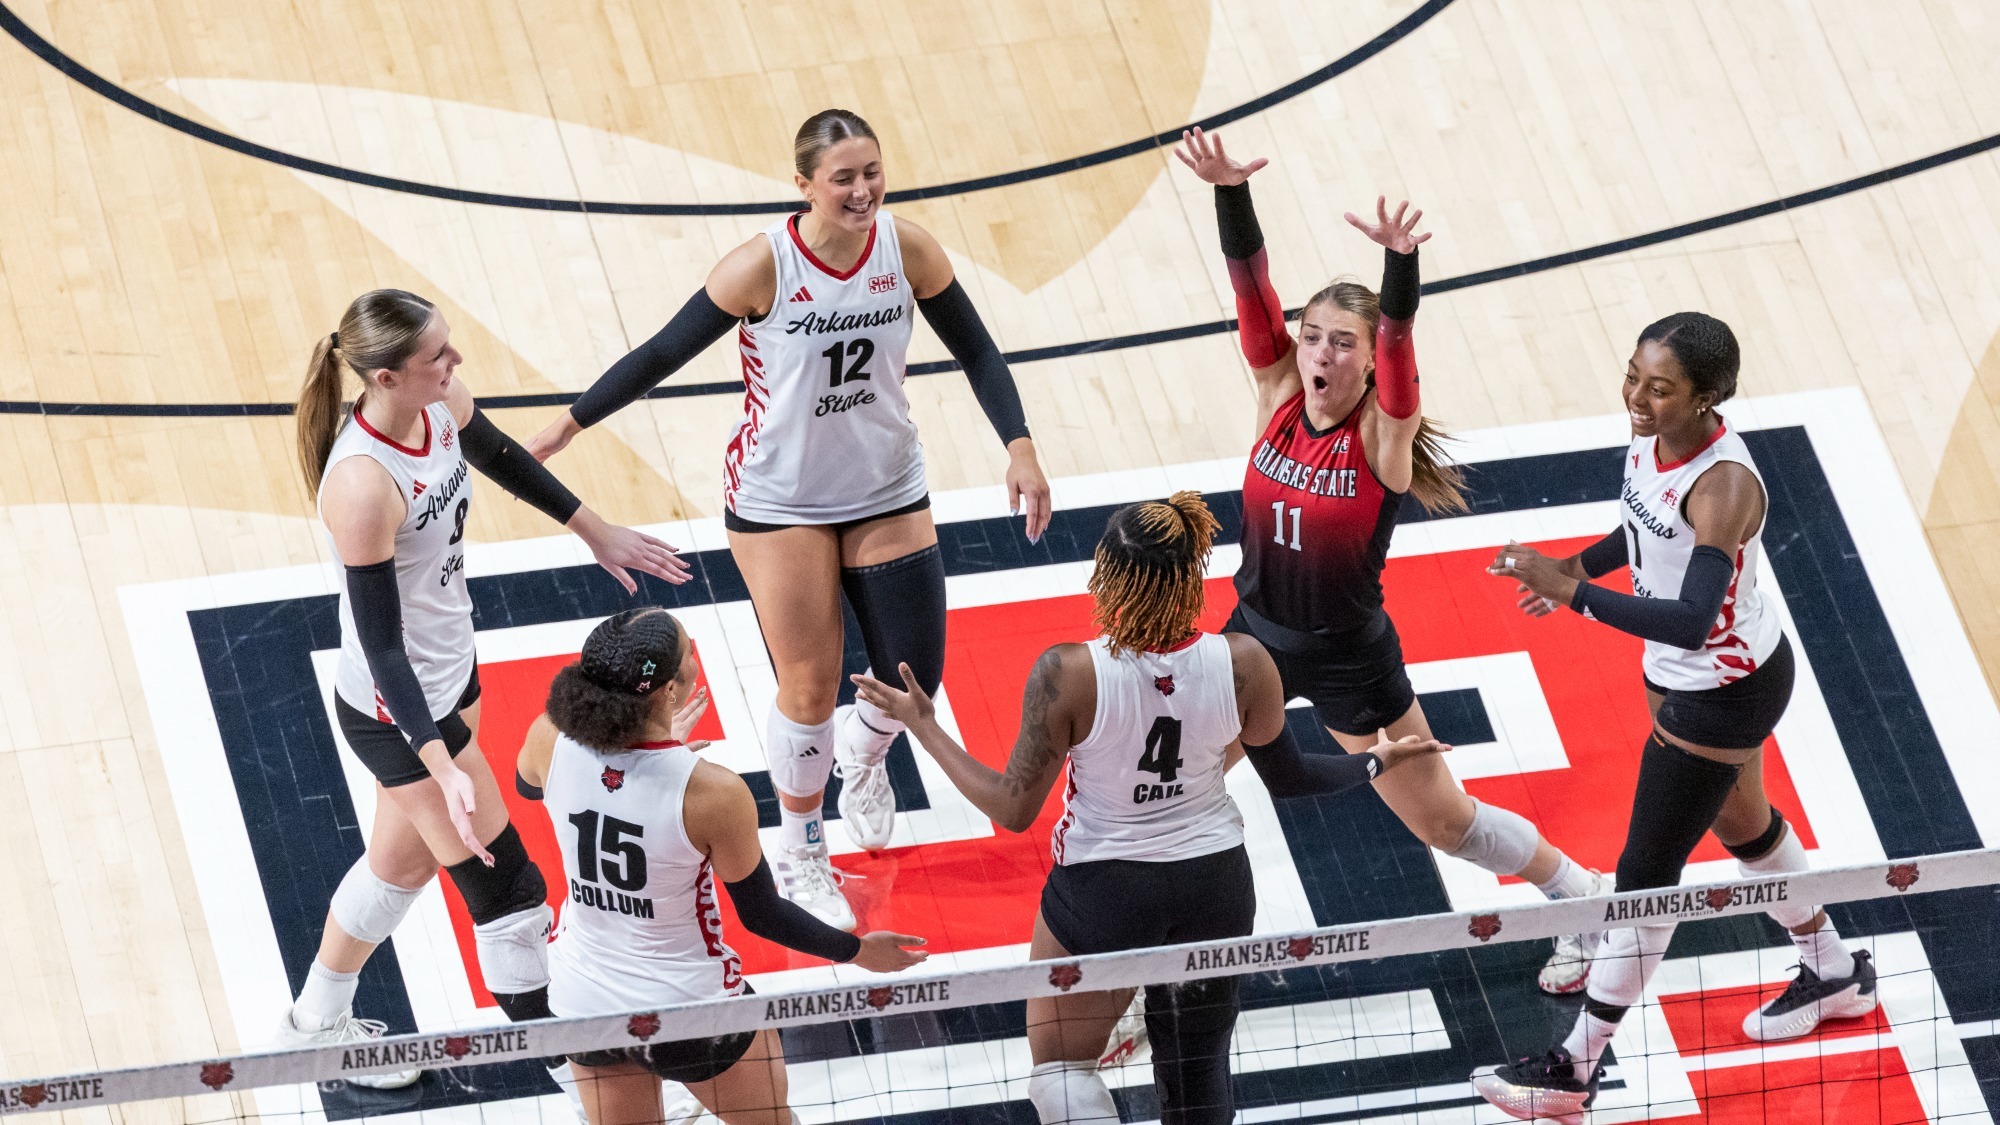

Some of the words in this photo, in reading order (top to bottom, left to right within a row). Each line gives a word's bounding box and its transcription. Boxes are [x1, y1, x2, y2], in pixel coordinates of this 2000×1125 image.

[868, 272, 898, 295] SBC
[785, 304, 904, 336] Arkansas
[822, 338, 875, 388] 12
[815, 389, 878, 417] State
[1310, 469, 1357, 497] STATE
[1271, 500, 1302, 552] 11
[441, 554, 464, 587] Sta
[1137, 716, 1184, 783] 4
[568, 808, 648, 892] 15
[571, 878, 655, 920] COLLUM
[1603, 890, 1706, 922] ARKANSAS
[1732, 880, 1788, 906] STATE
[1185, 940, 1288, 972] ARKANSAS
[1314, 930, 1370, 956] STATE
[765, 989, 867, 1021] ARKANSAS
[894, 980, 950, 1005] STATE
[341, 1037, 445, 1070] ARKANSAS
[471, 1030, 528, 1056] STATE
[47, 1078, 104, 1104] STATE
